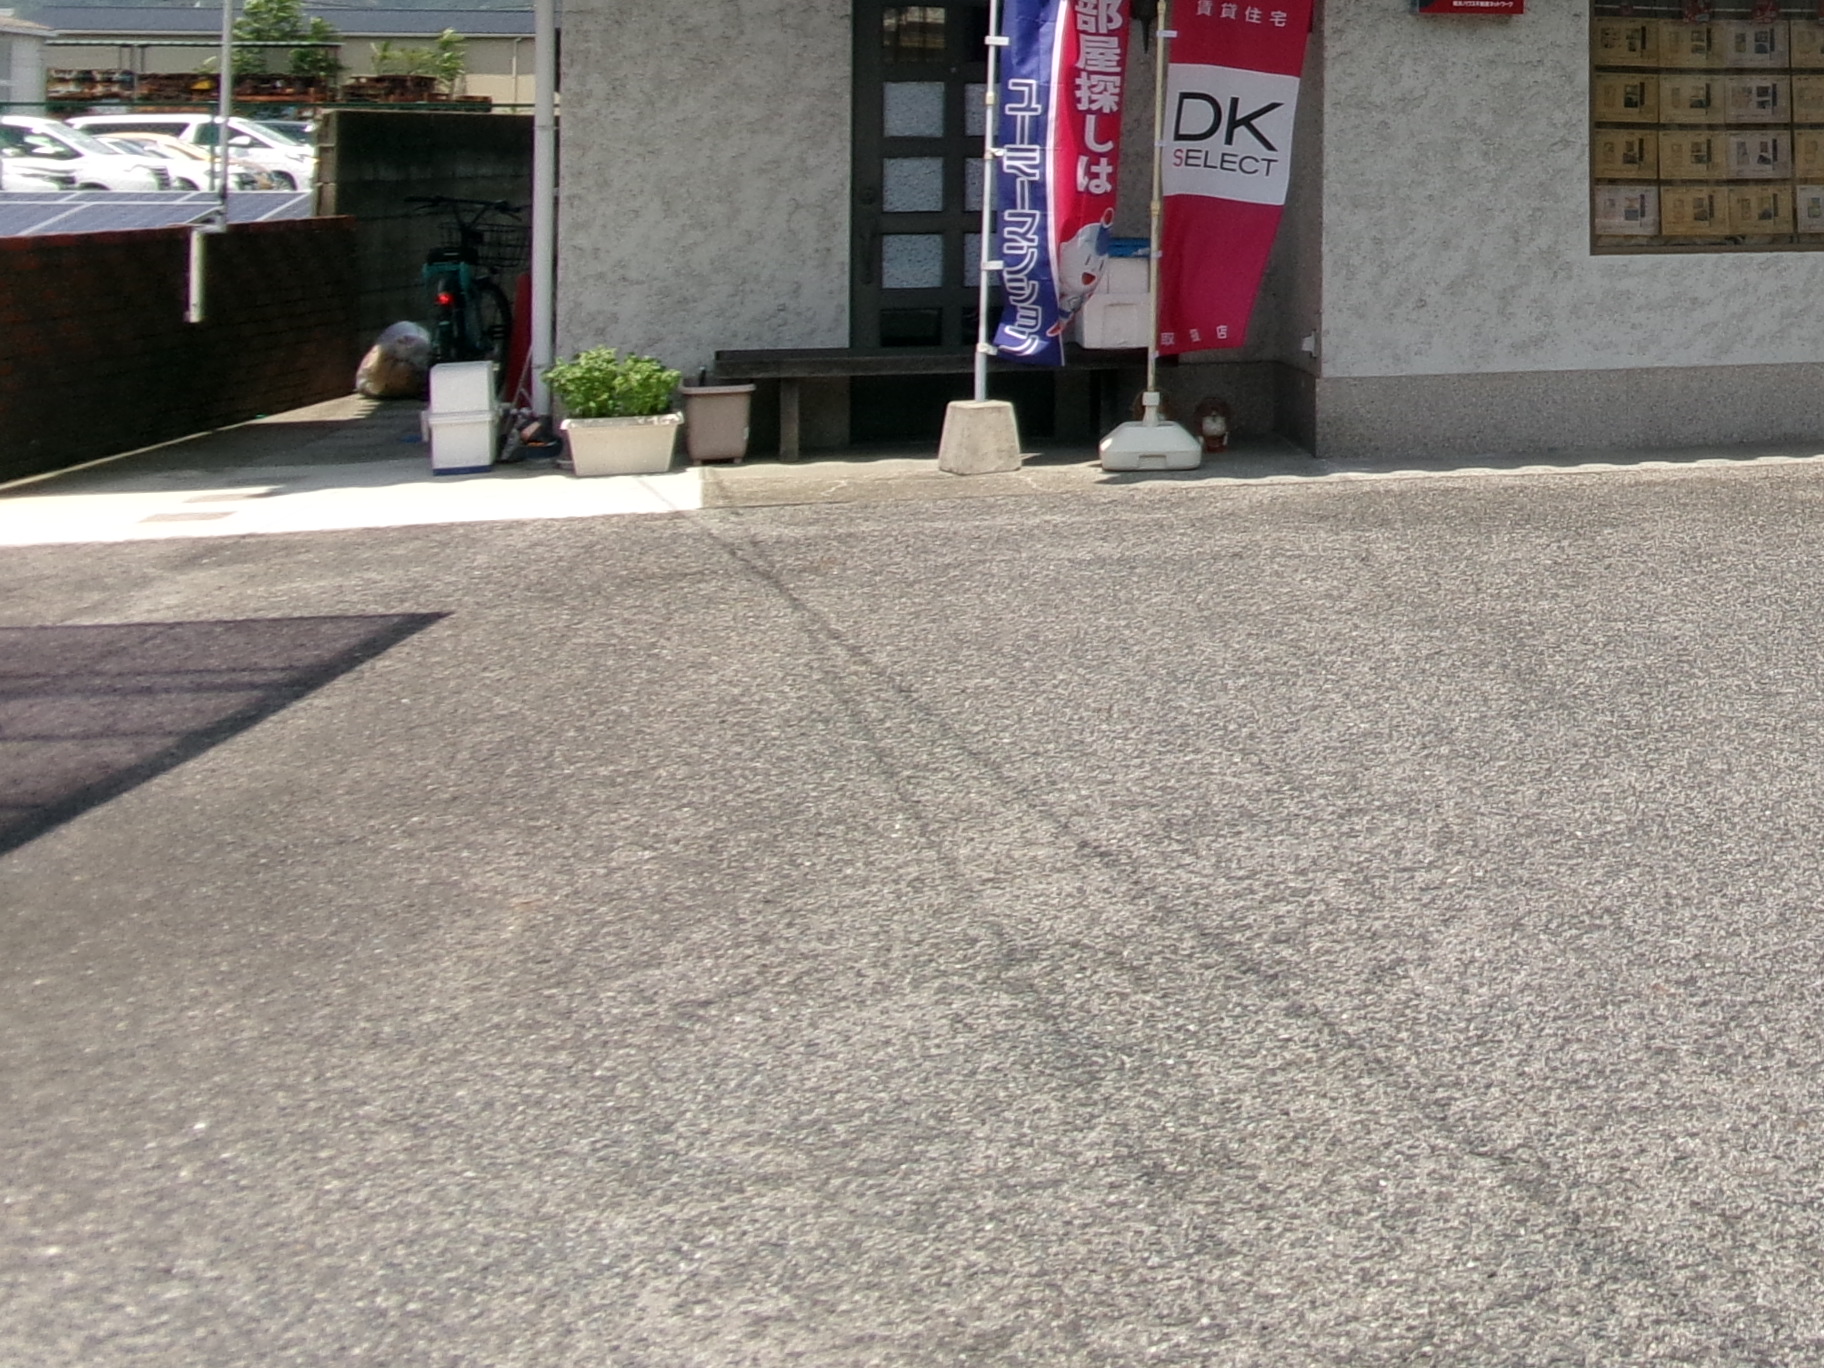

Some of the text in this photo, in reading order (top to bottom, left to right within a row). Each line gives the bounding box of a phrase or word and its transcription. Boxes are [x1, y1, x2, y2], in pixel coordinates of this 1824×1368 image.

[1195, 0, 1288, 28] 賃貸住宅
[1173, 91, 1285, 152] DK
[1172, 148, 1279, 177] SELECT
[998, 79, 1043, 357] ユーミーマンション
